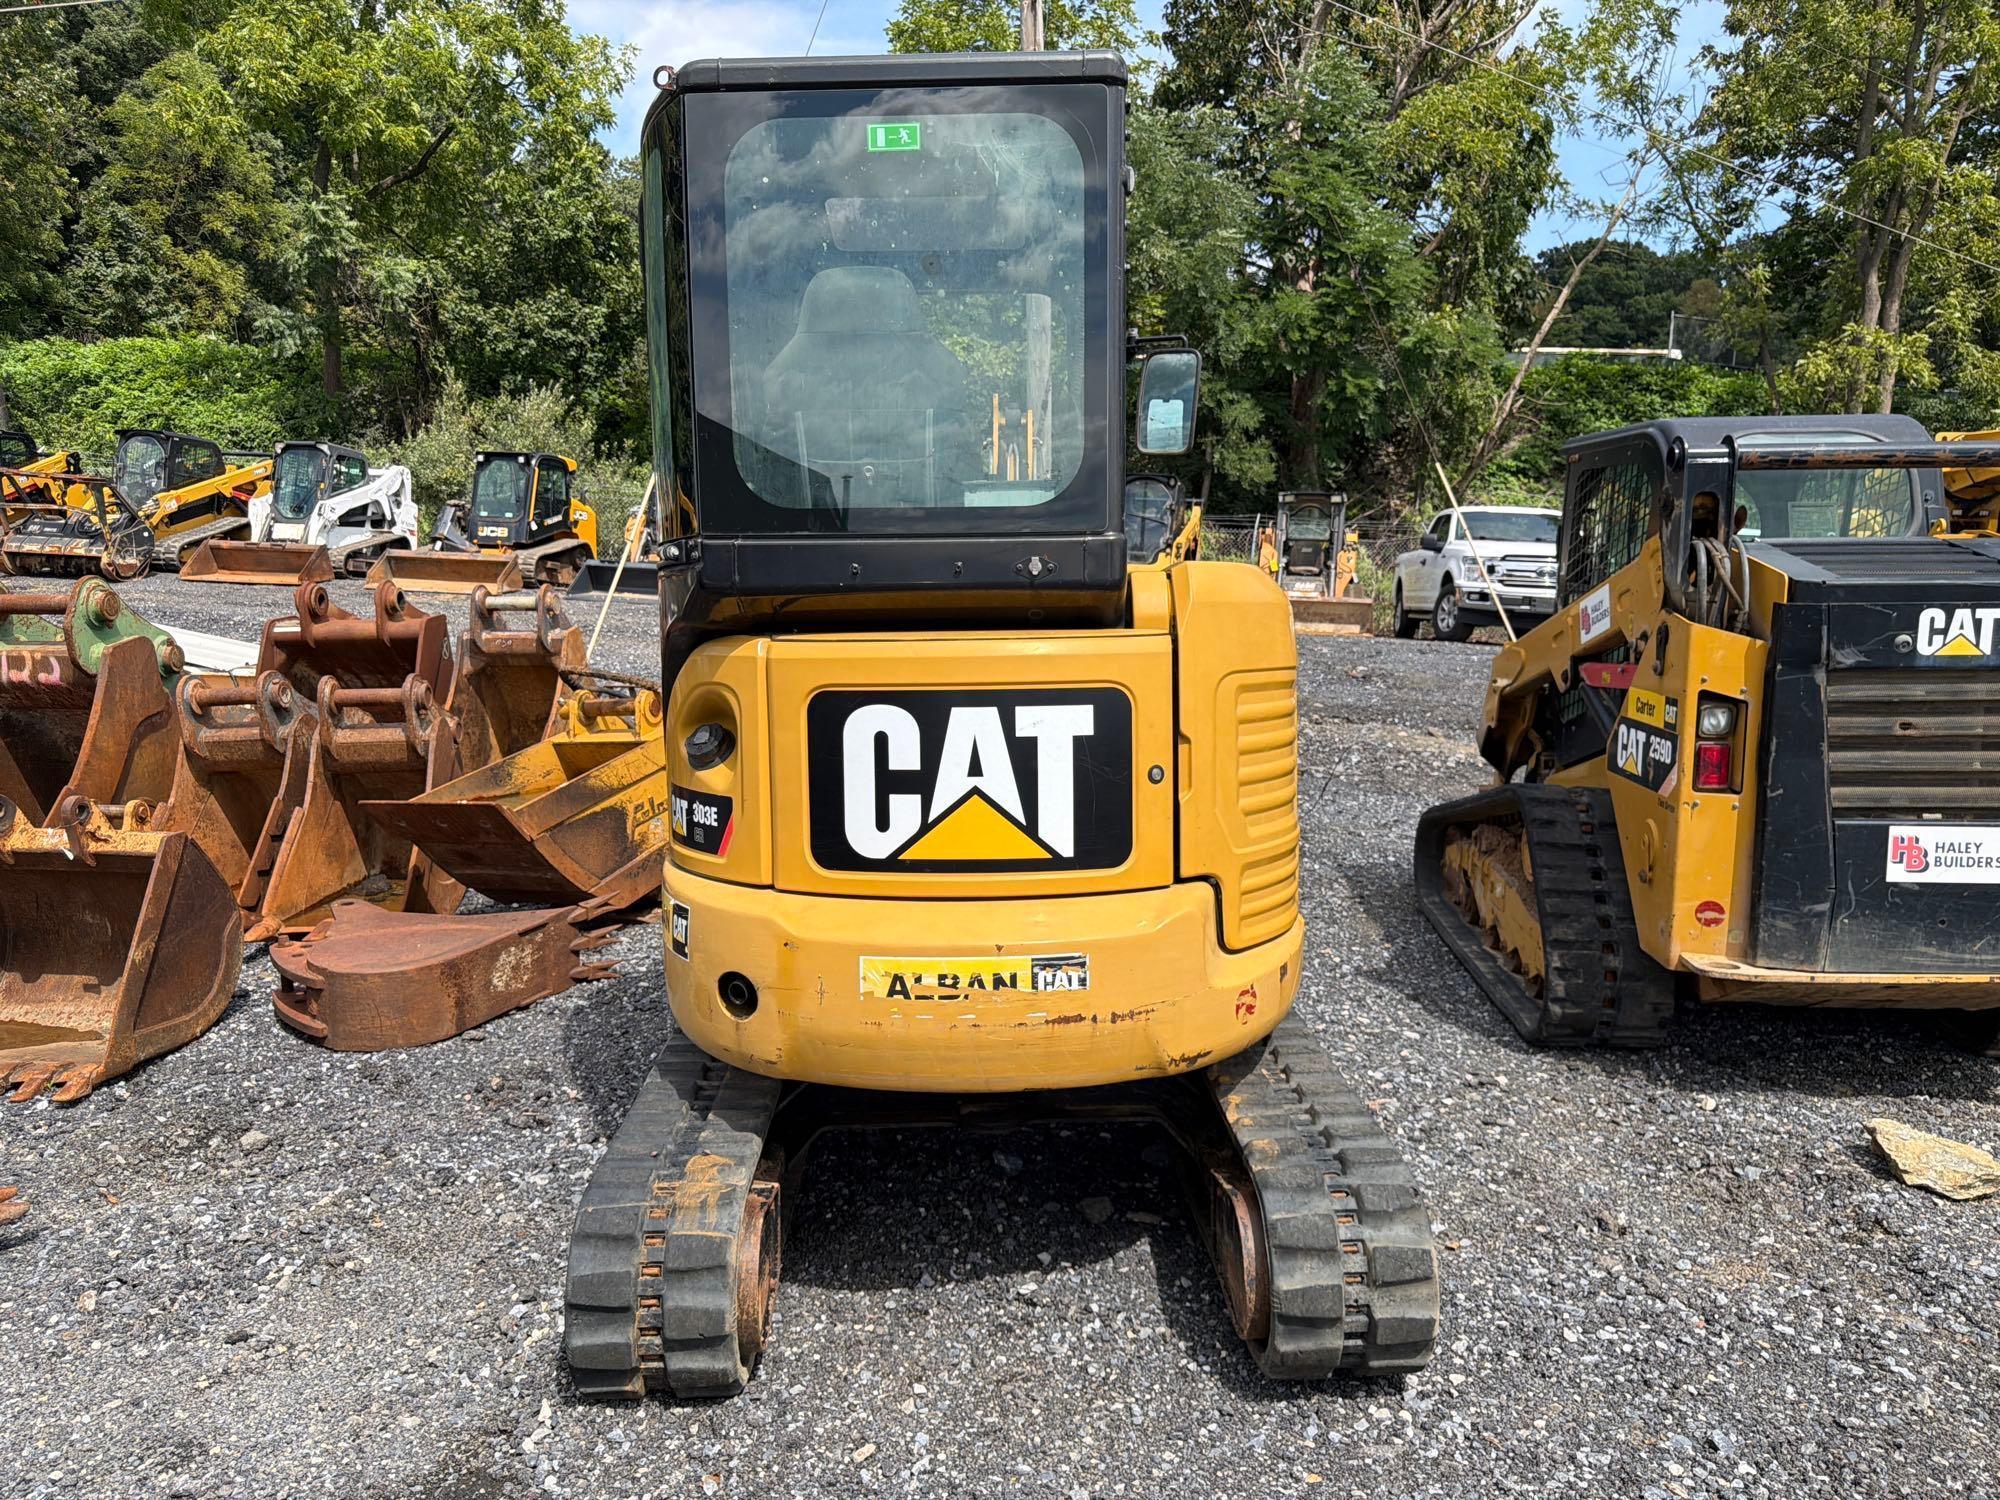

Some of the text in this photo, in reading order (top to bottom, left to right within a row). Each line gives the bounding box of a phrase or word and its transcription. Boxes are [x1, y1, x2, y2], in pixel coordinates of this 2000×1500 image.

[574, 510, 588, 520] JCB
[478, 526, 508, 537] JCB
[1917, 608, 2000, 655] CAT
[1635, 696, 1678, 724] Carter CAT
[1616, 723, 1672, 777] CAT 259D
[842, 704, 1094, 859] CAT
[671, 794, 719, 837] CAT 303E
[1934, 856, 2000, 869] BUILDERS
[1935, 842, 1983, 854] HALEY
[674, 914, 688, 944] CAT
